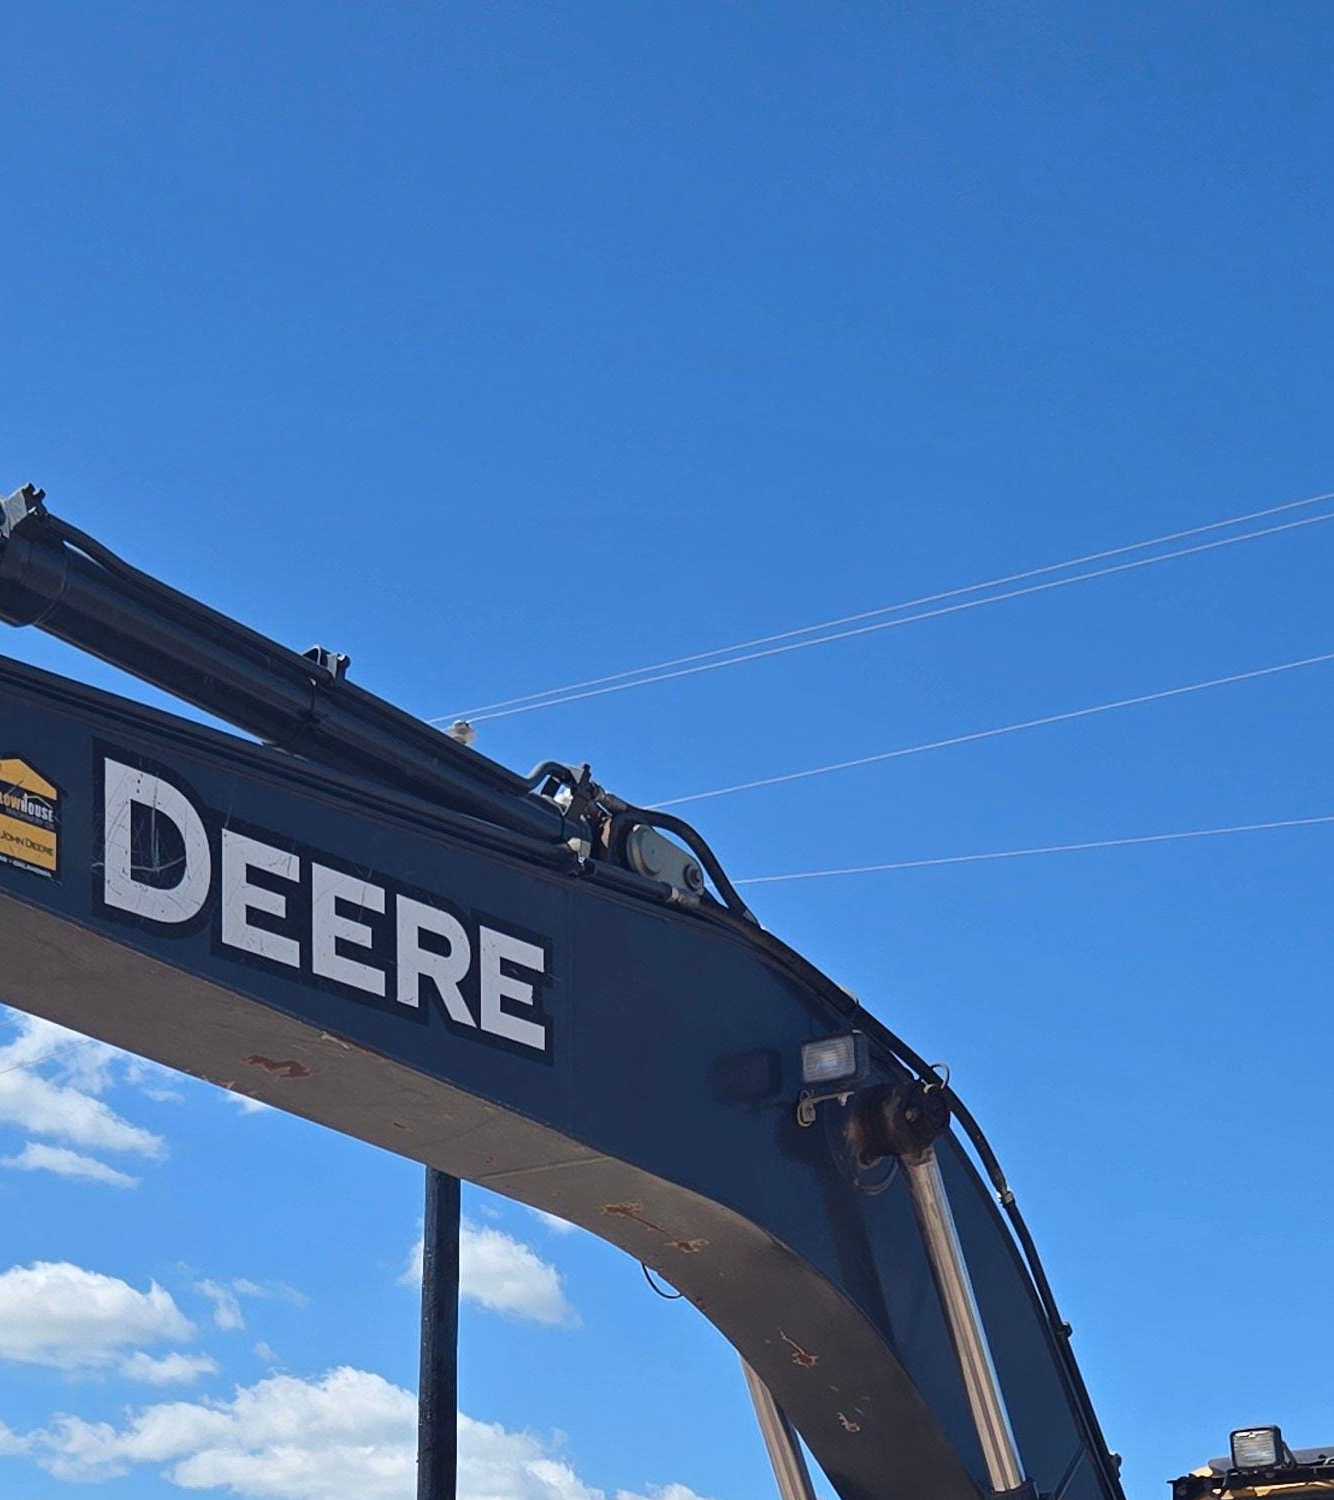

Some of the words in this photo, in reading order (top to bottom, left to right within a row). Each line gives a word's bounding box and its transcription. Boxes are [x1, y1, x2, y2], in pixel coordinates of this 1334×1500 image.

[0, 830, 25, 846] JOHN
[25, 837, 54, 856] DEERE
[104, 757, 546, 1051] DEERE
